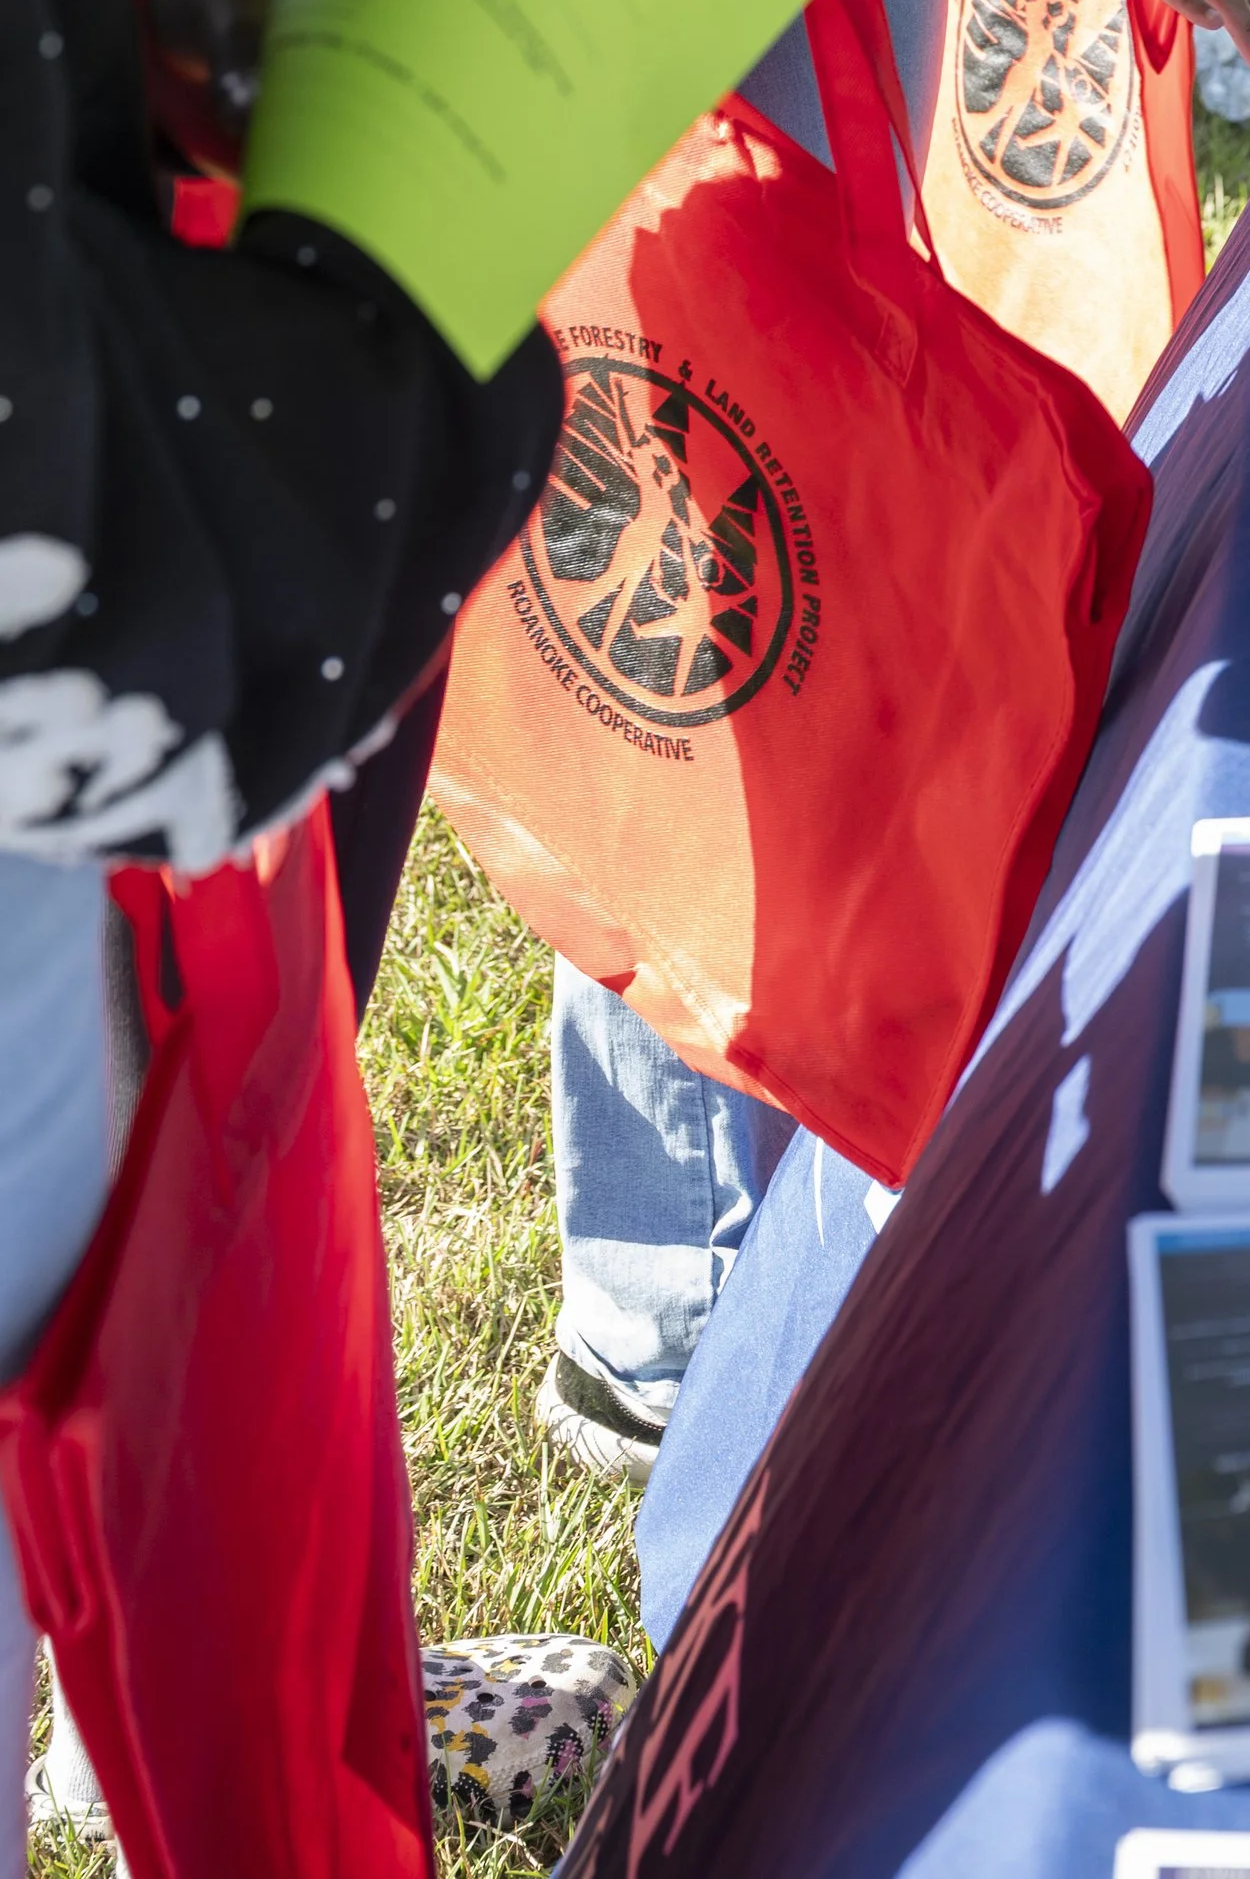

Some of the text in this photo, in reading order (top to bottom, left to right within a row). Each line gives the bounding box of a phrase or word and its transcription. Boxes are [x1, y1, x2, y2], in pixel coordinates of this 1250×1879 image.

[569, 326, 821, 696] FORESTRY & LAND RETENTION PROJECT
[507, 579, 695, 762] ROANOKE COOPERATIVE
